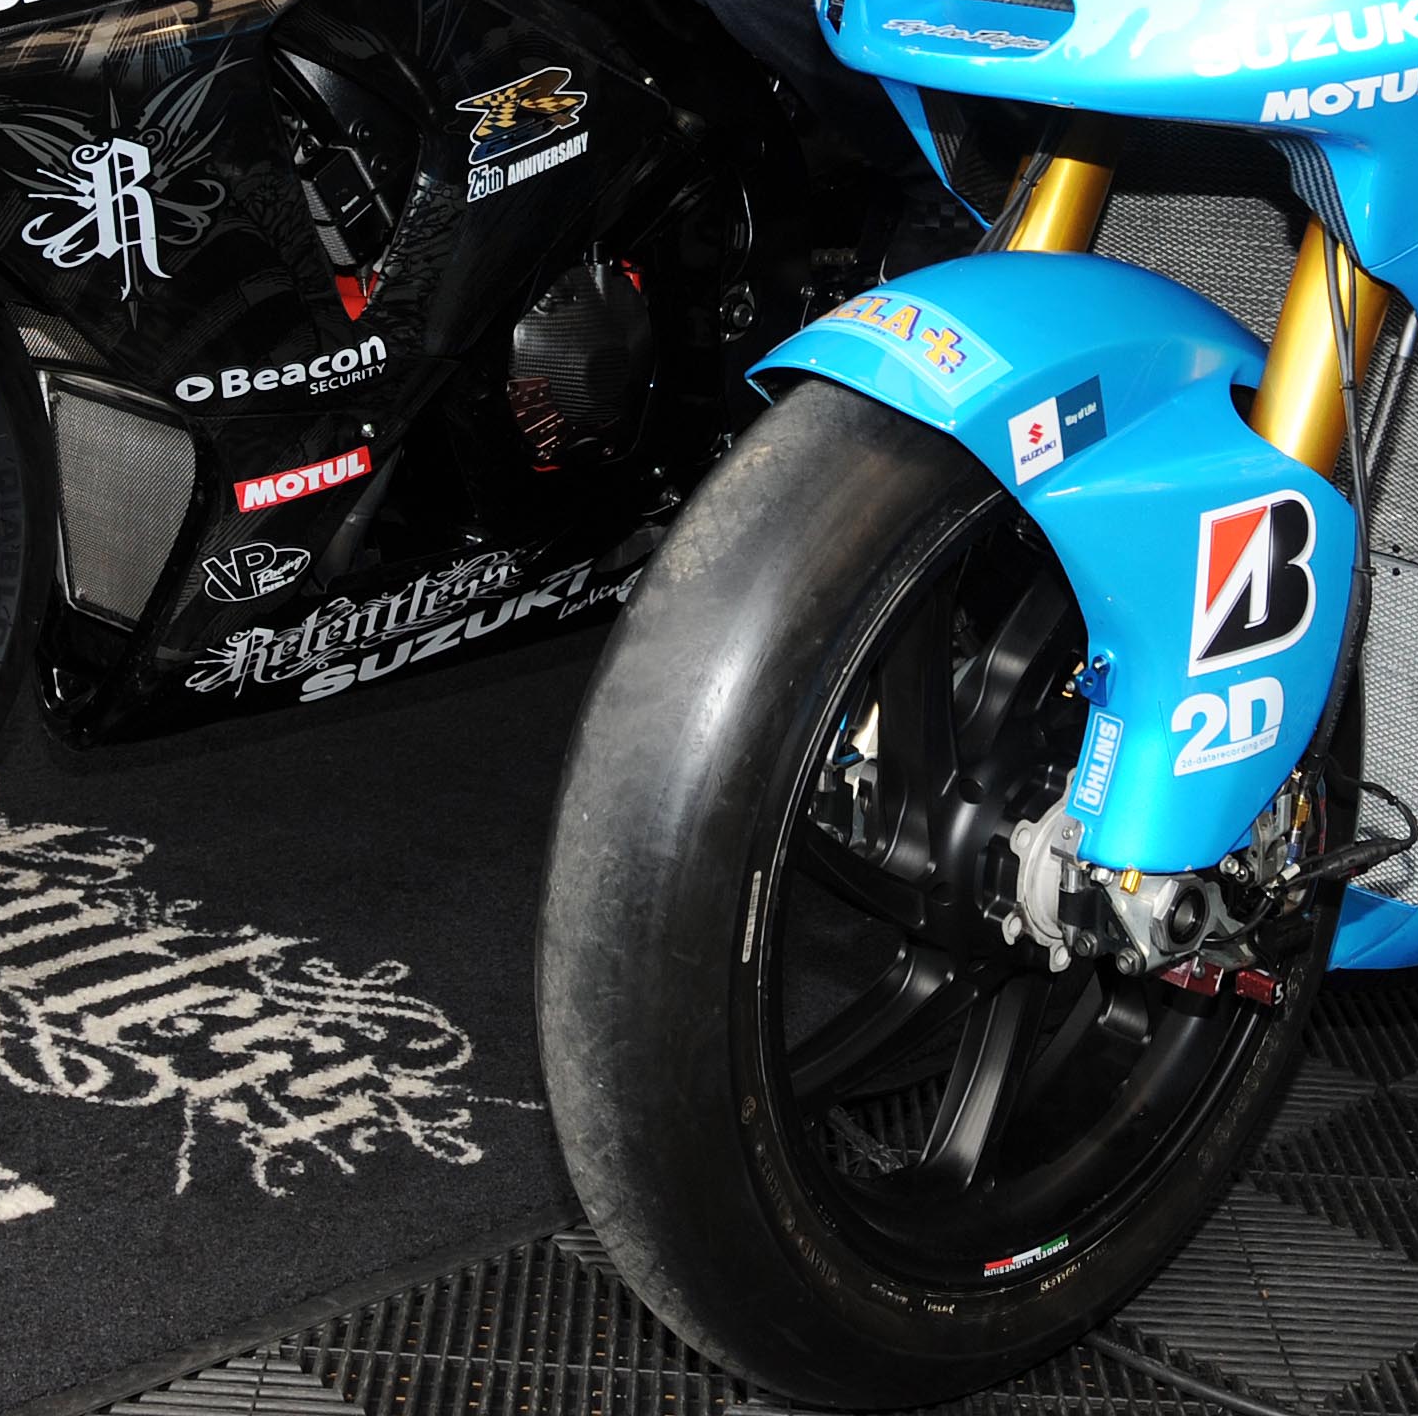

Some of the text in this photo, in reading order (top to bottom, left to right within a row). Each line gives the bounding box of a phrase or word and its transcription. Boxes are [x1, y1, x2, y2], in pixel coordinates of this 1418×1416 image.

[507, 130, 590, 187] ANNIVERSARY
[220, 335, 388, 400] Beacon
[308, 362, 388, 397] SECURITY
[1019, 438, 1058, 466] SUZUKI
[243, 453, 368, 511] MOTUL
[201, 541, 279, 599] VP
[299, 559, 595, 703] SUZUKI
[1171, 676, 1285, 777] 2D
